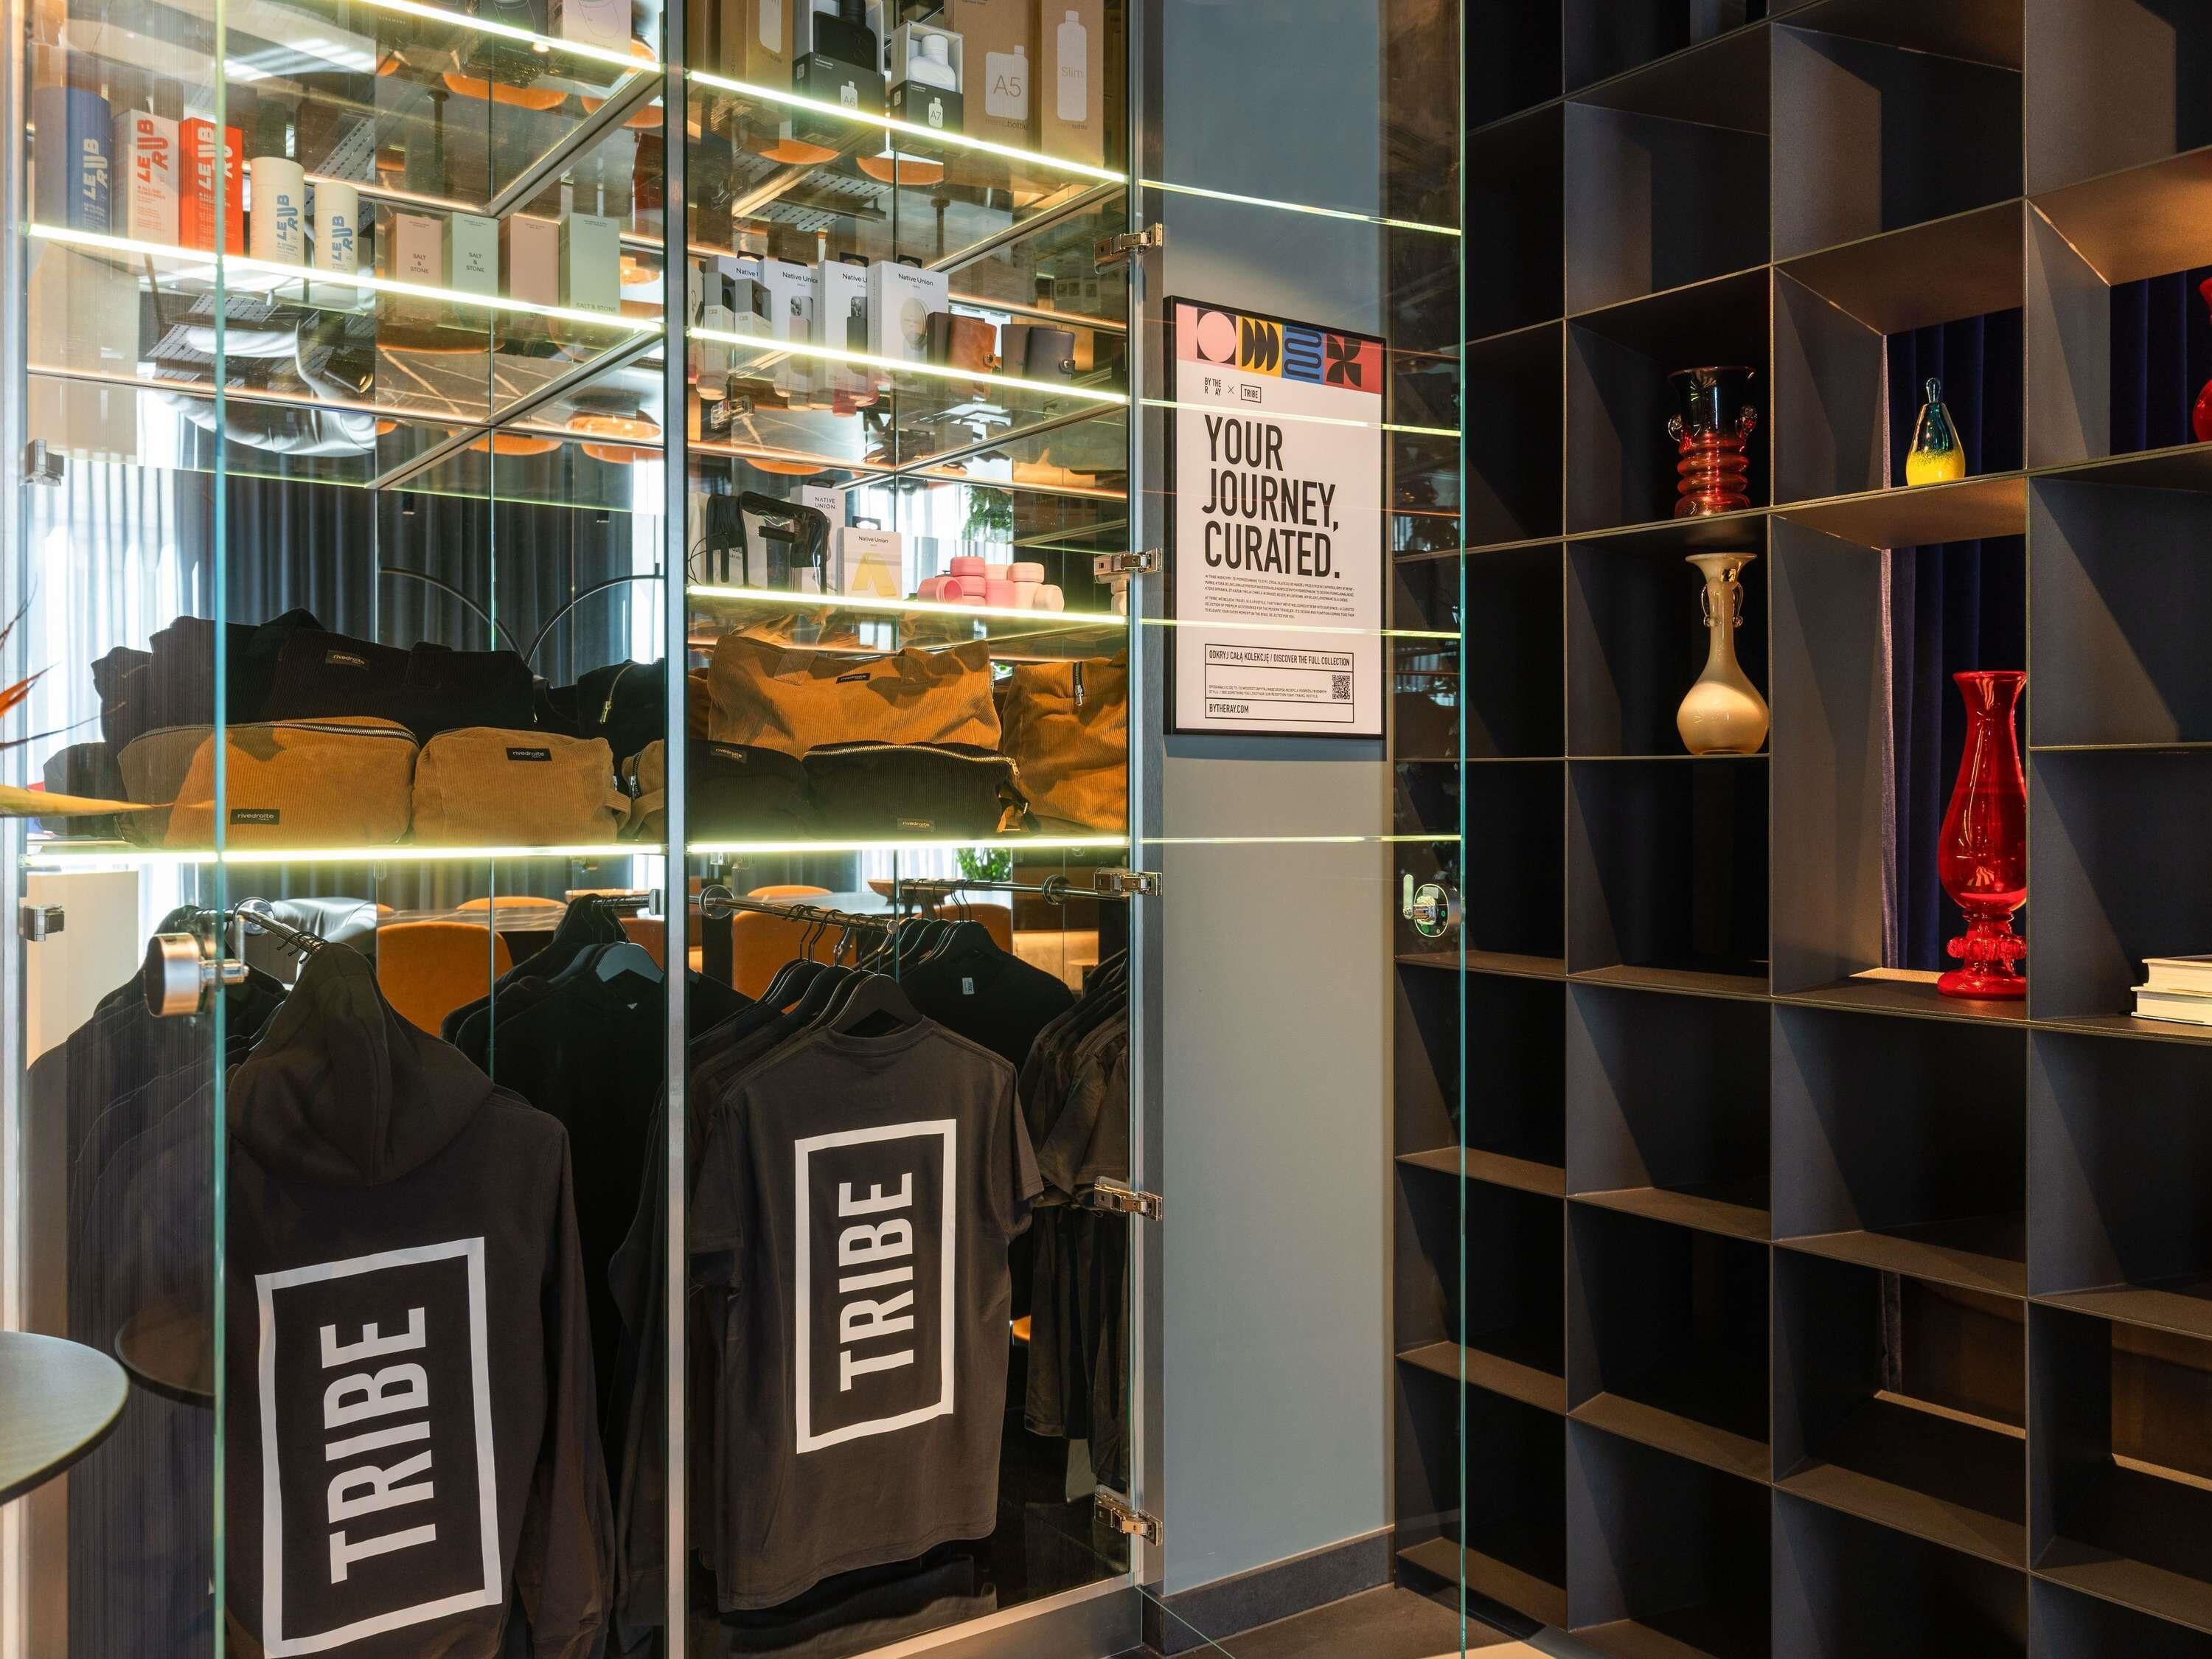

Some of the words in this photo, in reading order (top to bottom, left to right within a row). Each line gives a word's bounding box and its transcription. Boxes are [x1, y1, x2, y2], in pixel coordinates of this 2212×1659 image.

[1061, 66, 1083, 77] Slim
[992, 74, 1021, 97] A5
[931, 111, 942, 120] A7
[410, 265, 429, 274] STONE
[466, 265, 485, 274] STONE
[736, 268, 756, 277] Native
[782, 271, 801, 281] Native
[842, 273, 862, 282] Native
[898, 273, 917, 282] Native
[917, 277, 933, 286] Union
[1244, 388, 1258, 398] TRIBE
[1204, 414, 1284, 471] YOUR
[1201, 468, 1339, 532] JOURNEY,
[1205, 521, 1340, 579] CURATED.
[1209, 650, 1229, 660] ODKRYJ
[1230, 652, 1243, 662] CAŁĄ
[1244, 653, 1269, 664] KOLEKCJĘ
[1273, 654, 1298, 664] DISCOVER
[1298, 655, 1307, 664] THE
[1308, 655, 1320, 665] FULL
[1321, 656, 1350, 667] COLLECTION
[1209, 703, 1249, 714] BYTHERAY.COM
[838, 1172, 914, 1392] TRIBE
[319, 1307, 437, 1585] TRIBE
